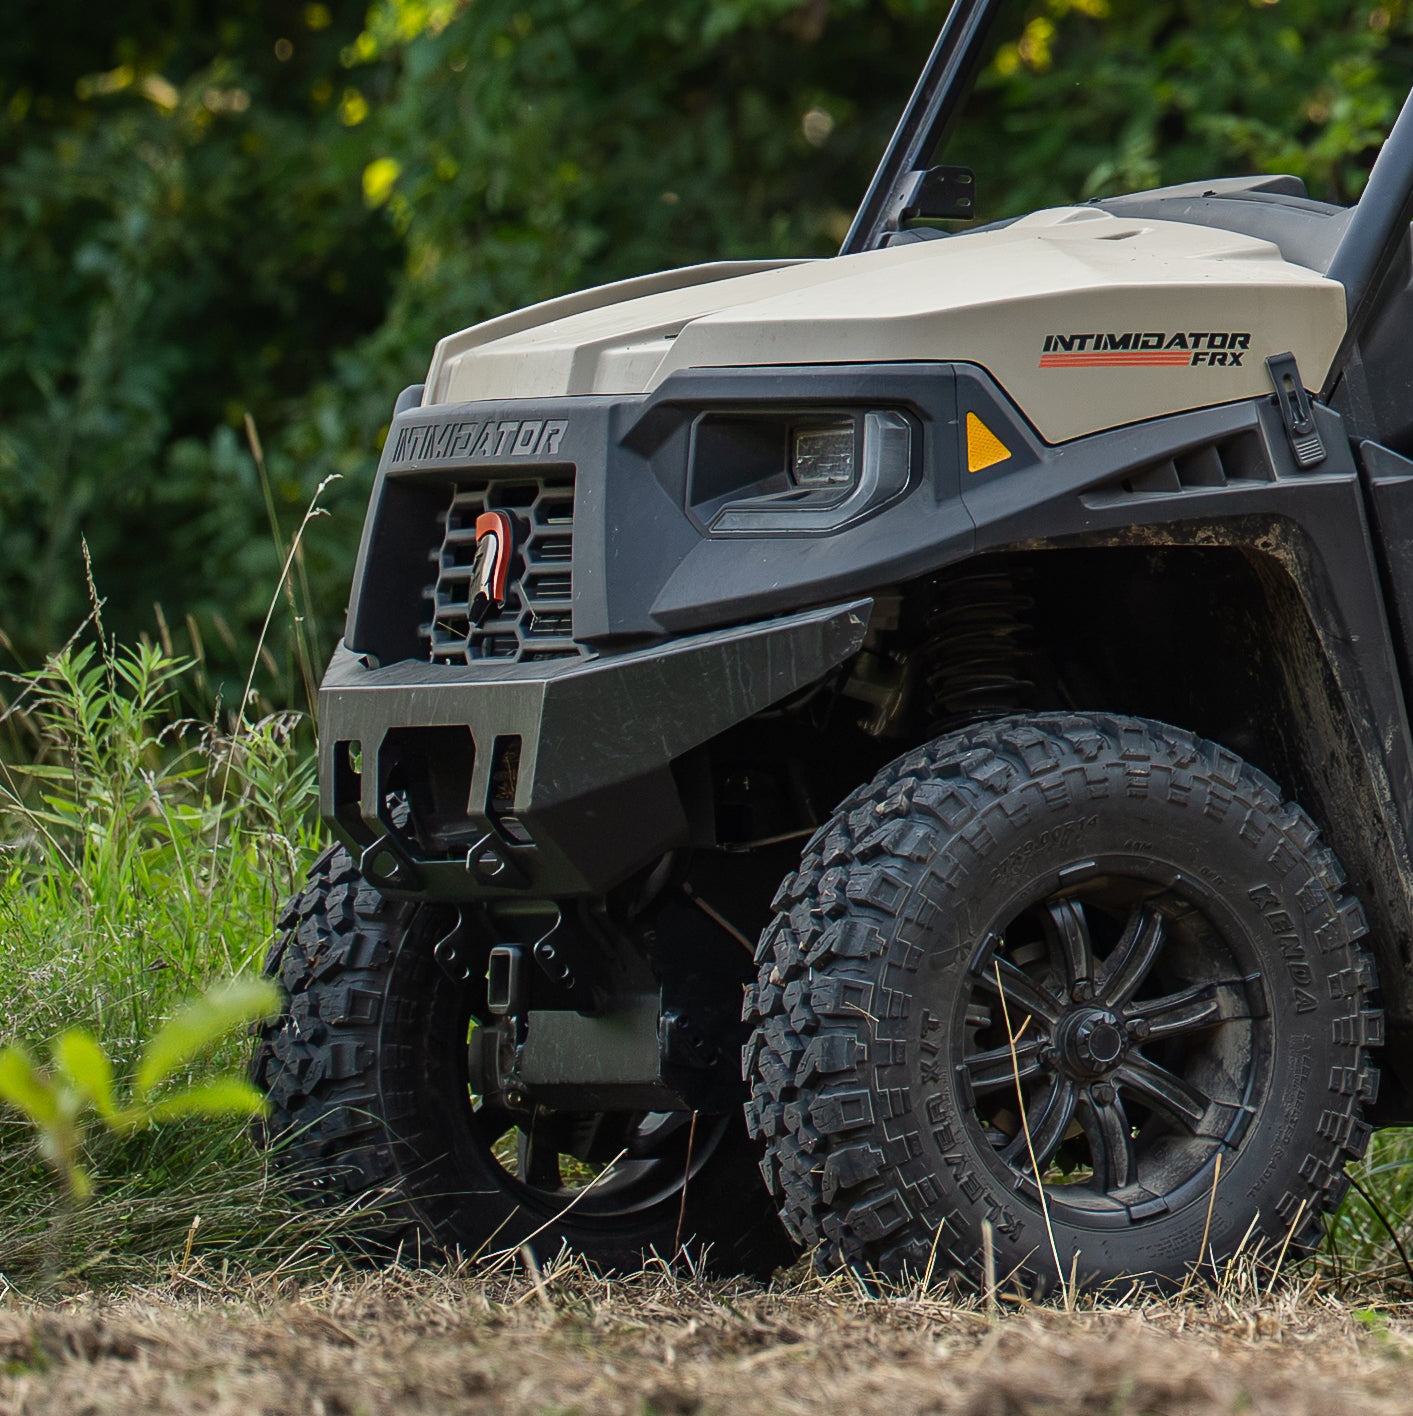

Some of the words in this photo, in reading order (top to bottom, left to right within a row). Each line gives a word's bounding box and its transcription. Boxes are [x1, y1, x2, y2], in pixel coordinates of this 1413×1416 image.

[1042, 332, 1251, 352] INTIMIDATOR
[1190, 351, 1244, 367] FRX
[392, 418, 569, 464] INTIMIDATOR
[1247, 883, 1320, 1014] KENDA
